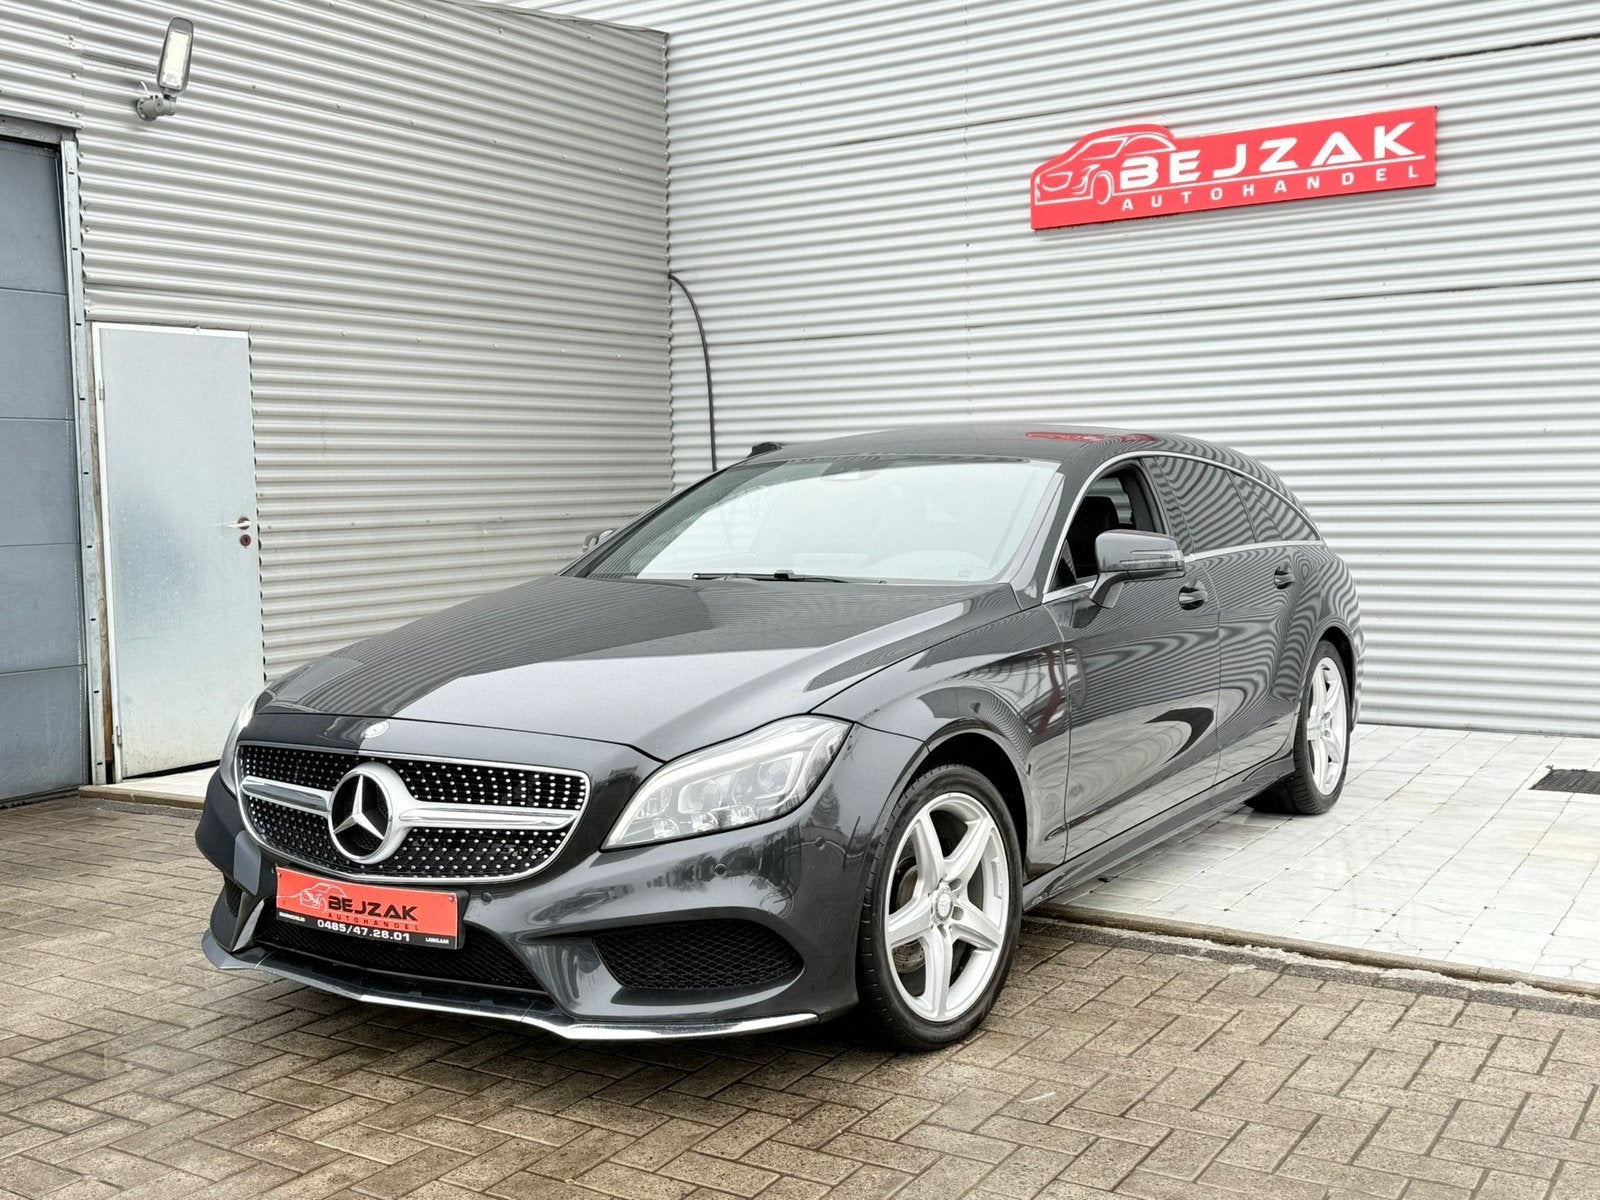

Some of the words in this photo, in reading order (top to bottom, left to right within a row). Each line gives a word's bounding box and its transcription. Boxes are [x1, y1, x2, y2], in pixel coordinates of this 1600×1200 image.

[1120, 122, 1415, 190] BEJZAK
[1121, 165, 1419, 211] AUTOHANDEL
[328, 895, 418, 921] BEJZAK
[317, 918, 410, 942] 0485/47.28.01
[328, 913, 419, 931] AUTOHANDEL
